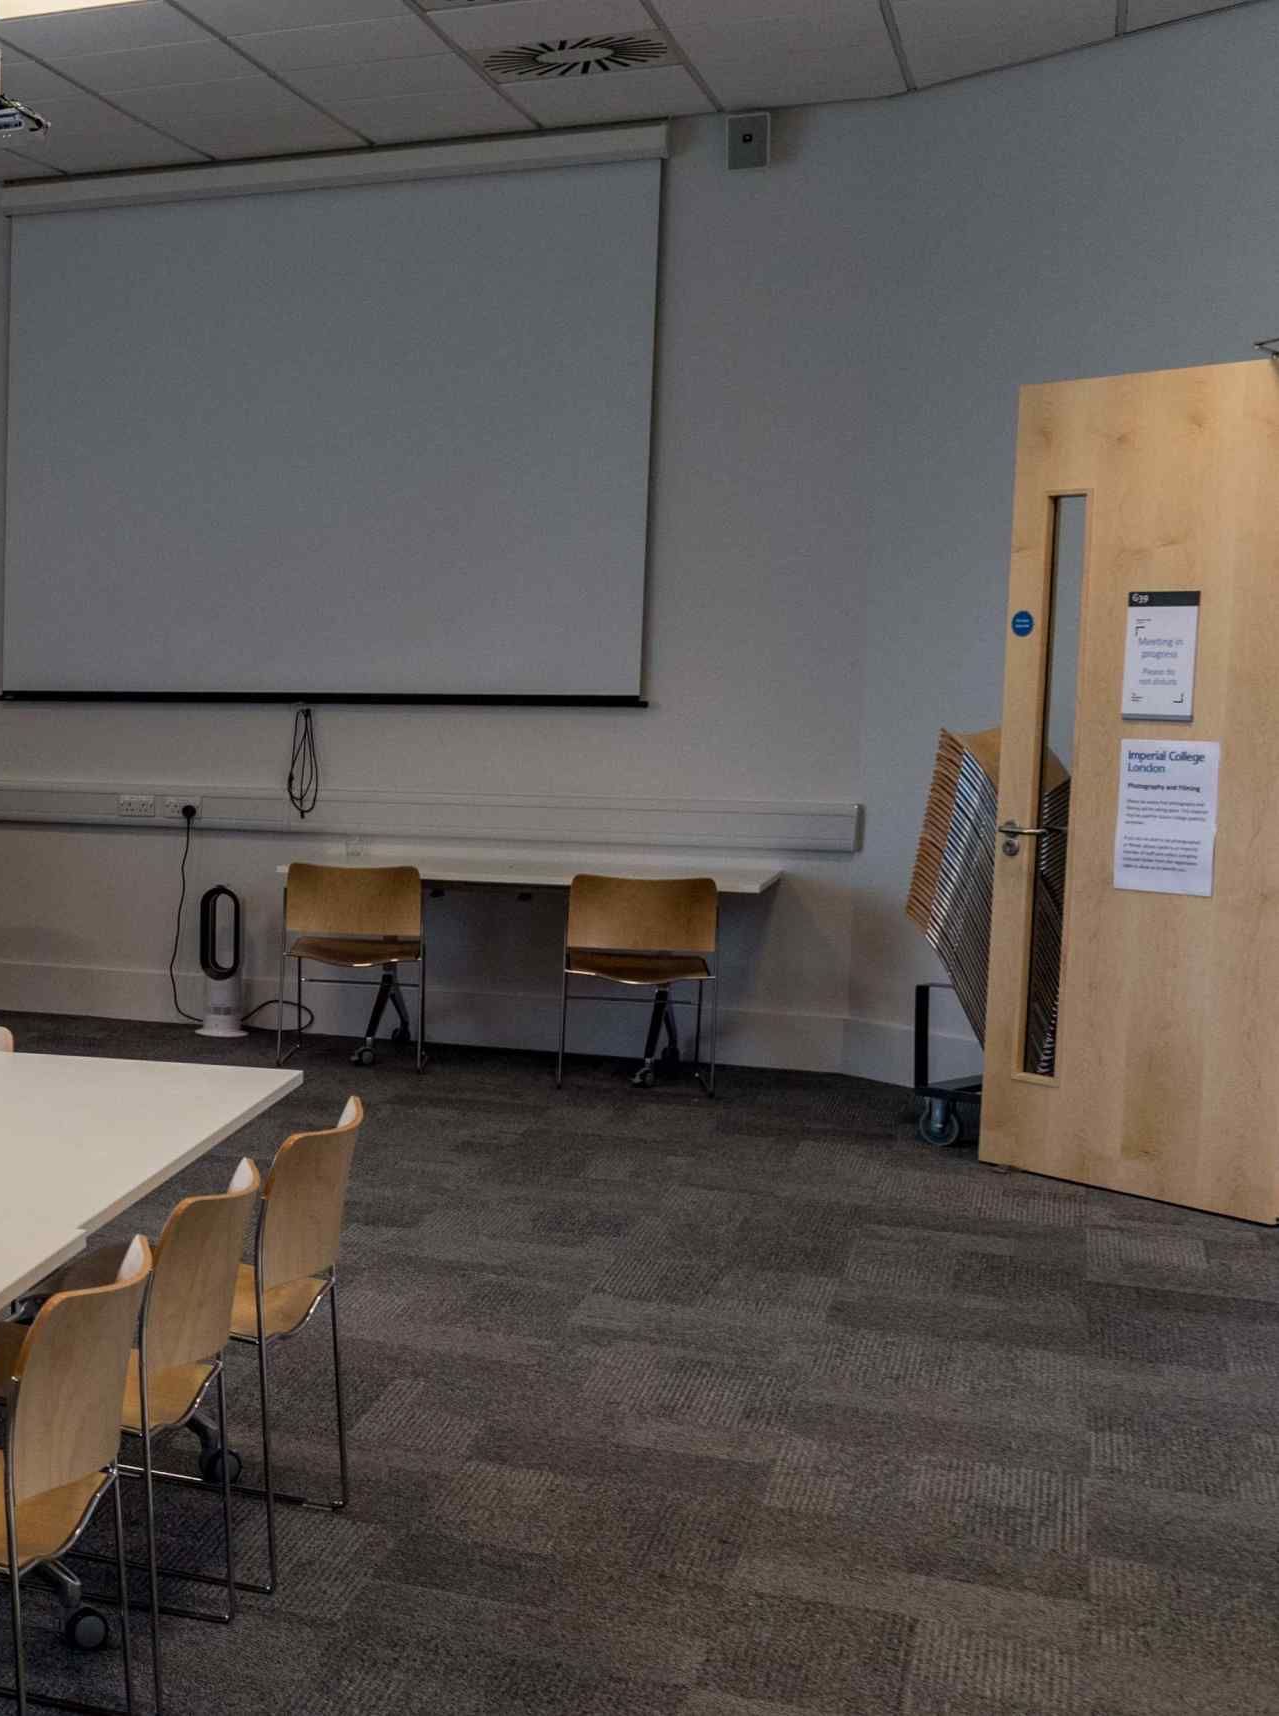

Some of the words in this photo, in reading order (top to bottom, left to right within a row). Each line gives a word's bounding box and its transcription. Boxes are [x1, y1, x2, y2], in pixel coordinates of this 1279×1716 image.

[1139, 637, 1173, 647] Meeting
[1141, 651, 1178, 659] progress
[1128, 750, 1166, 763] Imperial
[1169, 751, 1205, 765] College
[1128, 762, 1165, 773] London
